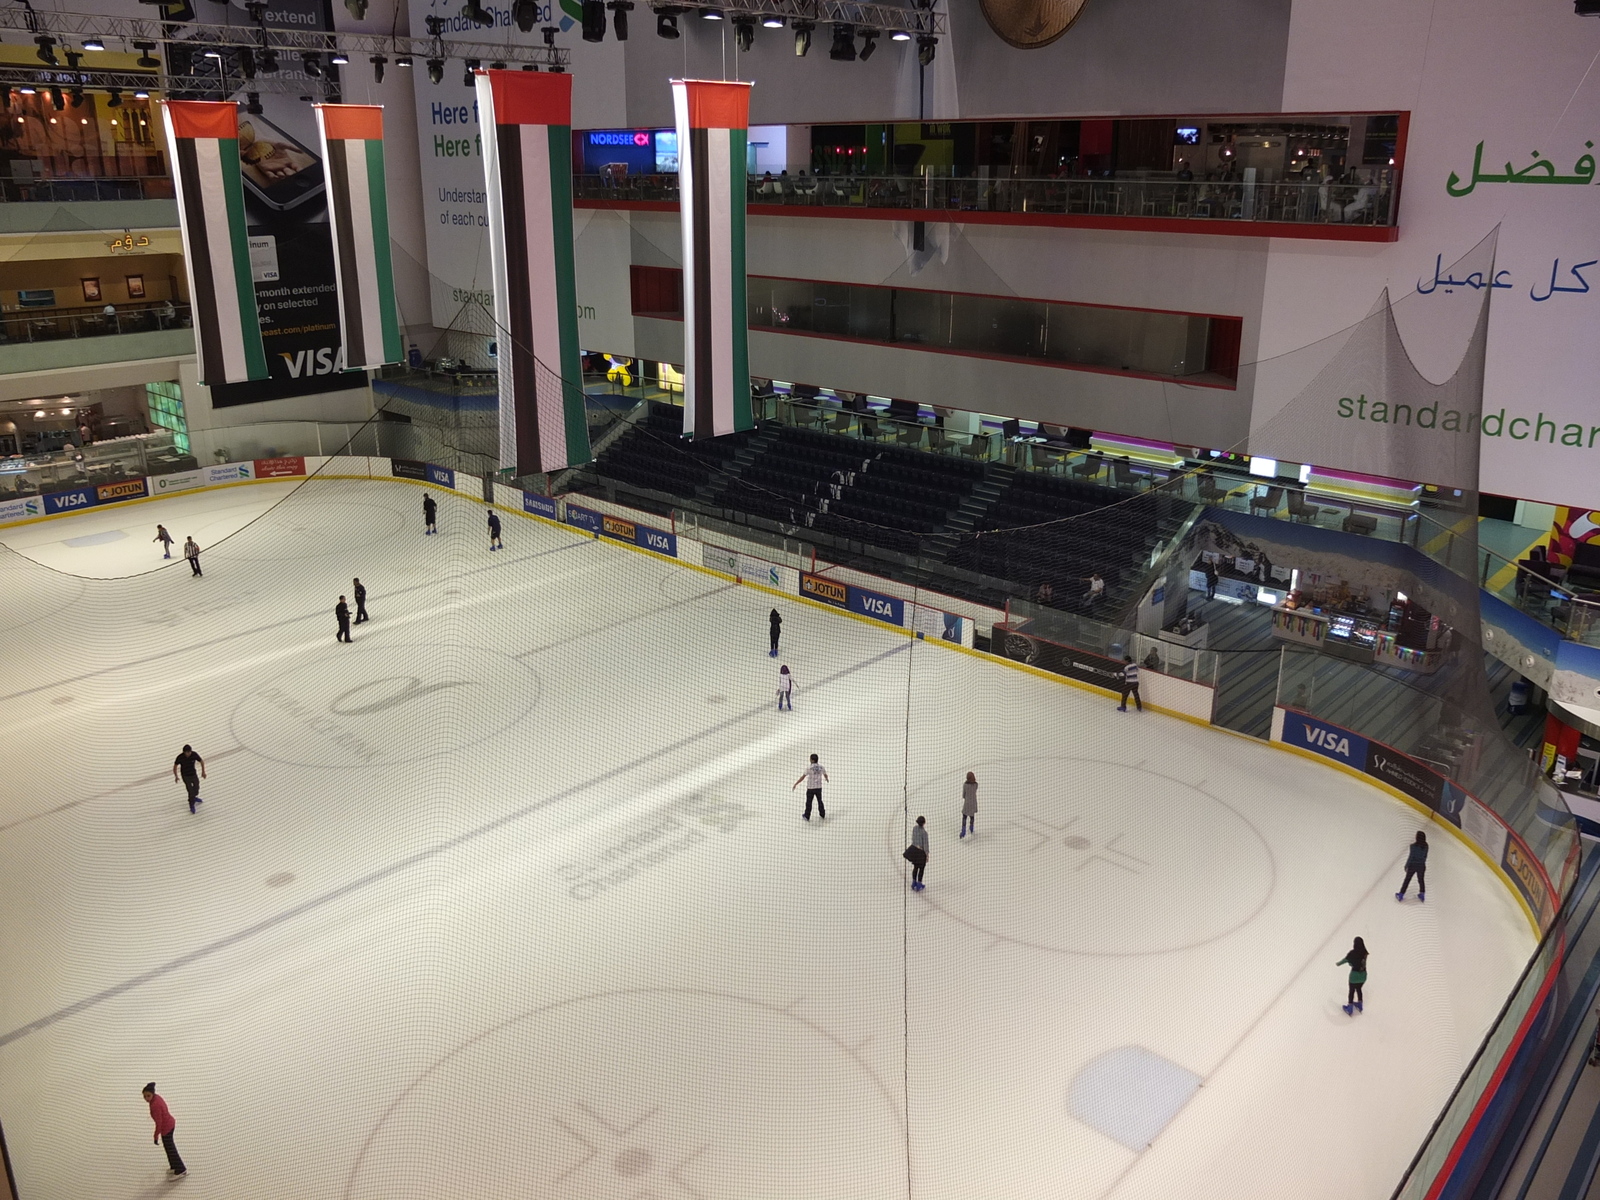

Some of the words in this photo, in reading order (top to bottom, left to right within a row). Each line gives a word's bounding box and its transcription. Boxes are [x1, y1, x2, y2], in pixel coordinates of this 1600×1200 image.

[265, 10, 317, 25] extend
[484, 4, 552, 30] Chared
[431, 101, 469, 125] Here
[434, 134, 470, 157] Here
[590, 133, 634, 146] NORDSEE
[438, 187, 488, 204] Understan
[440, 210, 449, 225] of
[452, 211, 475, 227] each
[249, 240, 269, 249] inum
[263, 271, 278, 279] VISA
[1416, 252, 1513, 294] عميل
[1530, 257, 1599, 302] كل
[256, 286, 291, 298] -month
[292, 283, 336, 295] extended
[277, 297, 319, 309] selected
[260, 316, 274, 324] es.
[261, 323, 336, 337] east.com/platinum
[209, 473, 238, 482] Chartered
[211, 467, 237, 475] Standard
[432, 470, 450, 484] VISA
[111, 483, 142, 496] JOTUN
[0, 503, 24, 512] andard
[54, 493, 88, 508] VISA
[525, 497, 554, 514] SAMSUNG
[0, 510, 25, 519] artered
[568, 509, 588, 522] SART
[612, 524, 634, 537] JOTUN
[647, 532, 670, 550] VISA
[813, 581, 844, 600] JOTUN
[861, 595, 893, 618] VISA
[1302, 723, 1350, 757] VISA
[1517, 861, 1542, 904] JOTUN
